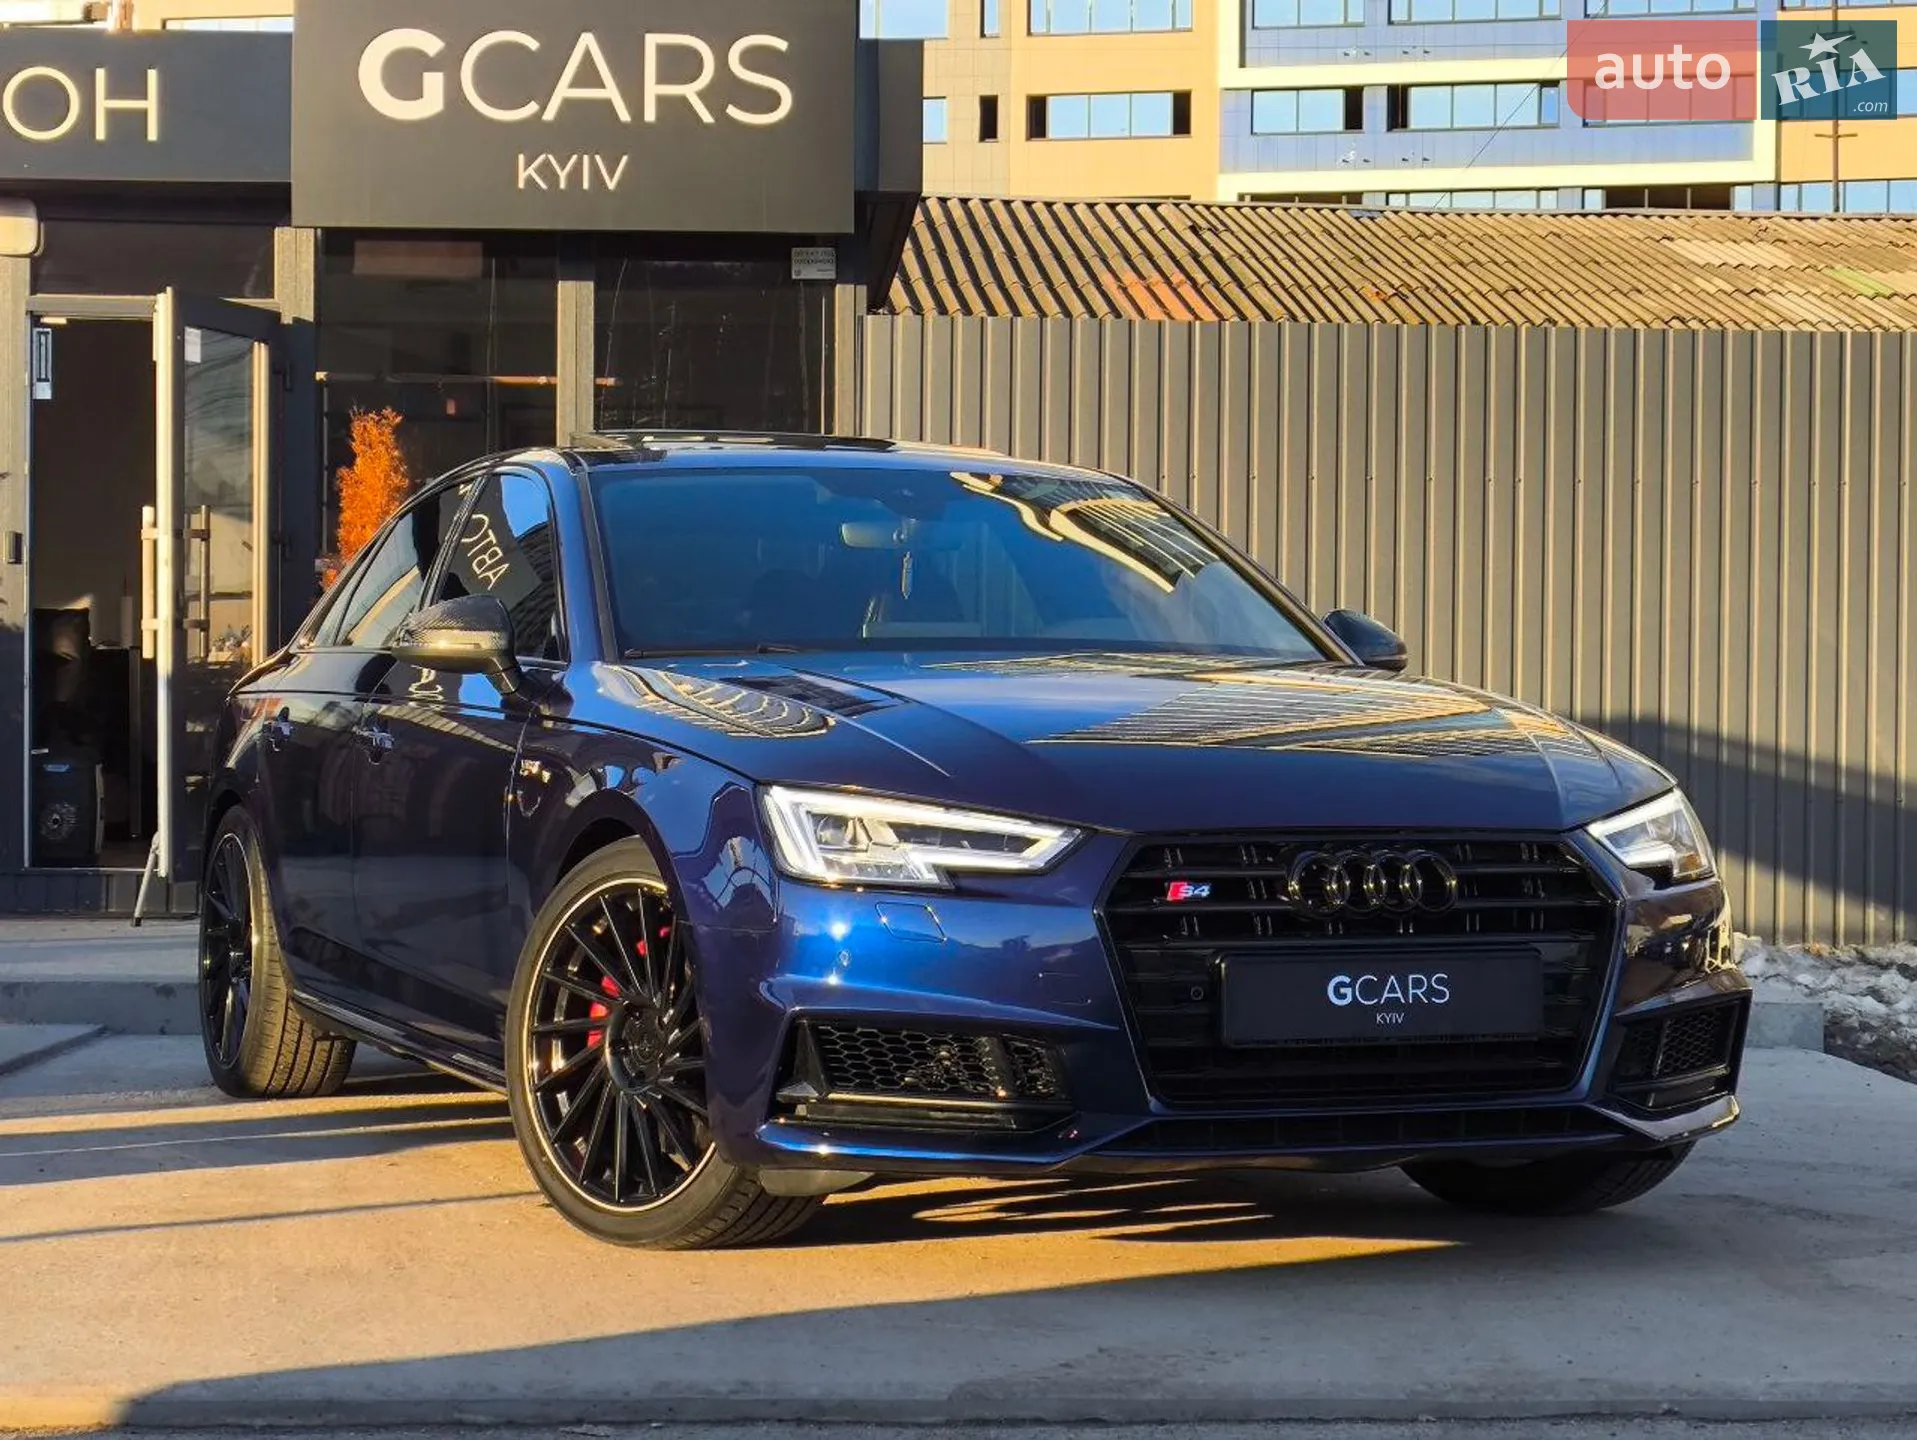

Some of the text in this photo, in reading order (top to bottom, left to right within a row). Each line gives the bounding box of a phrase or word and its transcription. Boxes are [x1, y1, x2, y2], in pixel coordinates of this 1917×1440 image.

[358, 28, 793, 125] GCARS
[517, 153, 629, 191] KYIV
[1178, 884, 1210, 899] S4
[1327, 973, 1450, 1006] GCARS
[1376, 1012, 1405, 1025] KYIV
